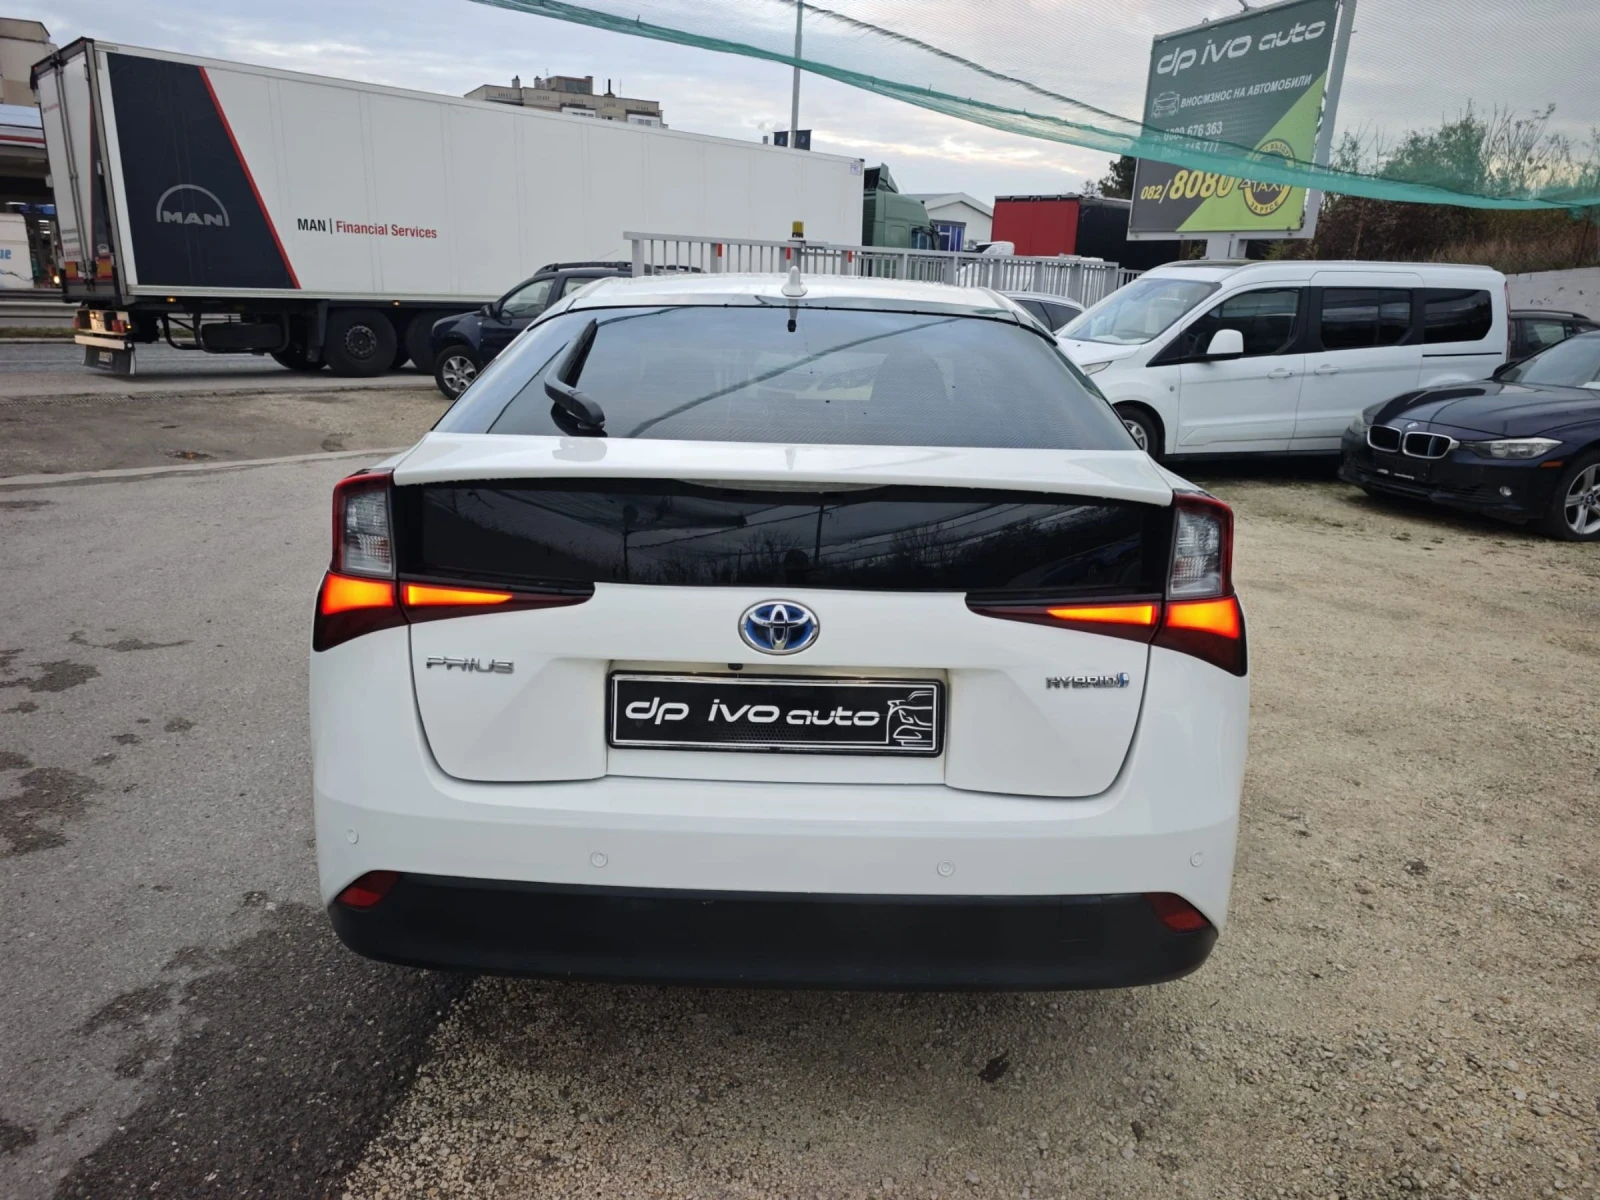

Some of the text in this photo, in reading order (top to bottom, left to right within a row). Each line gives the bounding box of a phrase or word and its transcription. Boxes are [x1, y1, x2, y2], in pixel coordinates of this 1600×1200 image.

[1156, 21, 1326, 76] dp ivo auto
[1233, 87, 1246, 99] НА
[1247, 74, 1313, 96] АВТОМОБИЛИ
[1205, 121, 1223, 136] 363
[162, 210, 223, 226] MAN
[297, 218, 437, 239] MAN Financial Services
[426, 656, 514, 675] PRIUS
[1045, 675, 1118, 690] HYBRID
[625, 697, 880, 726] dp ivo auto
